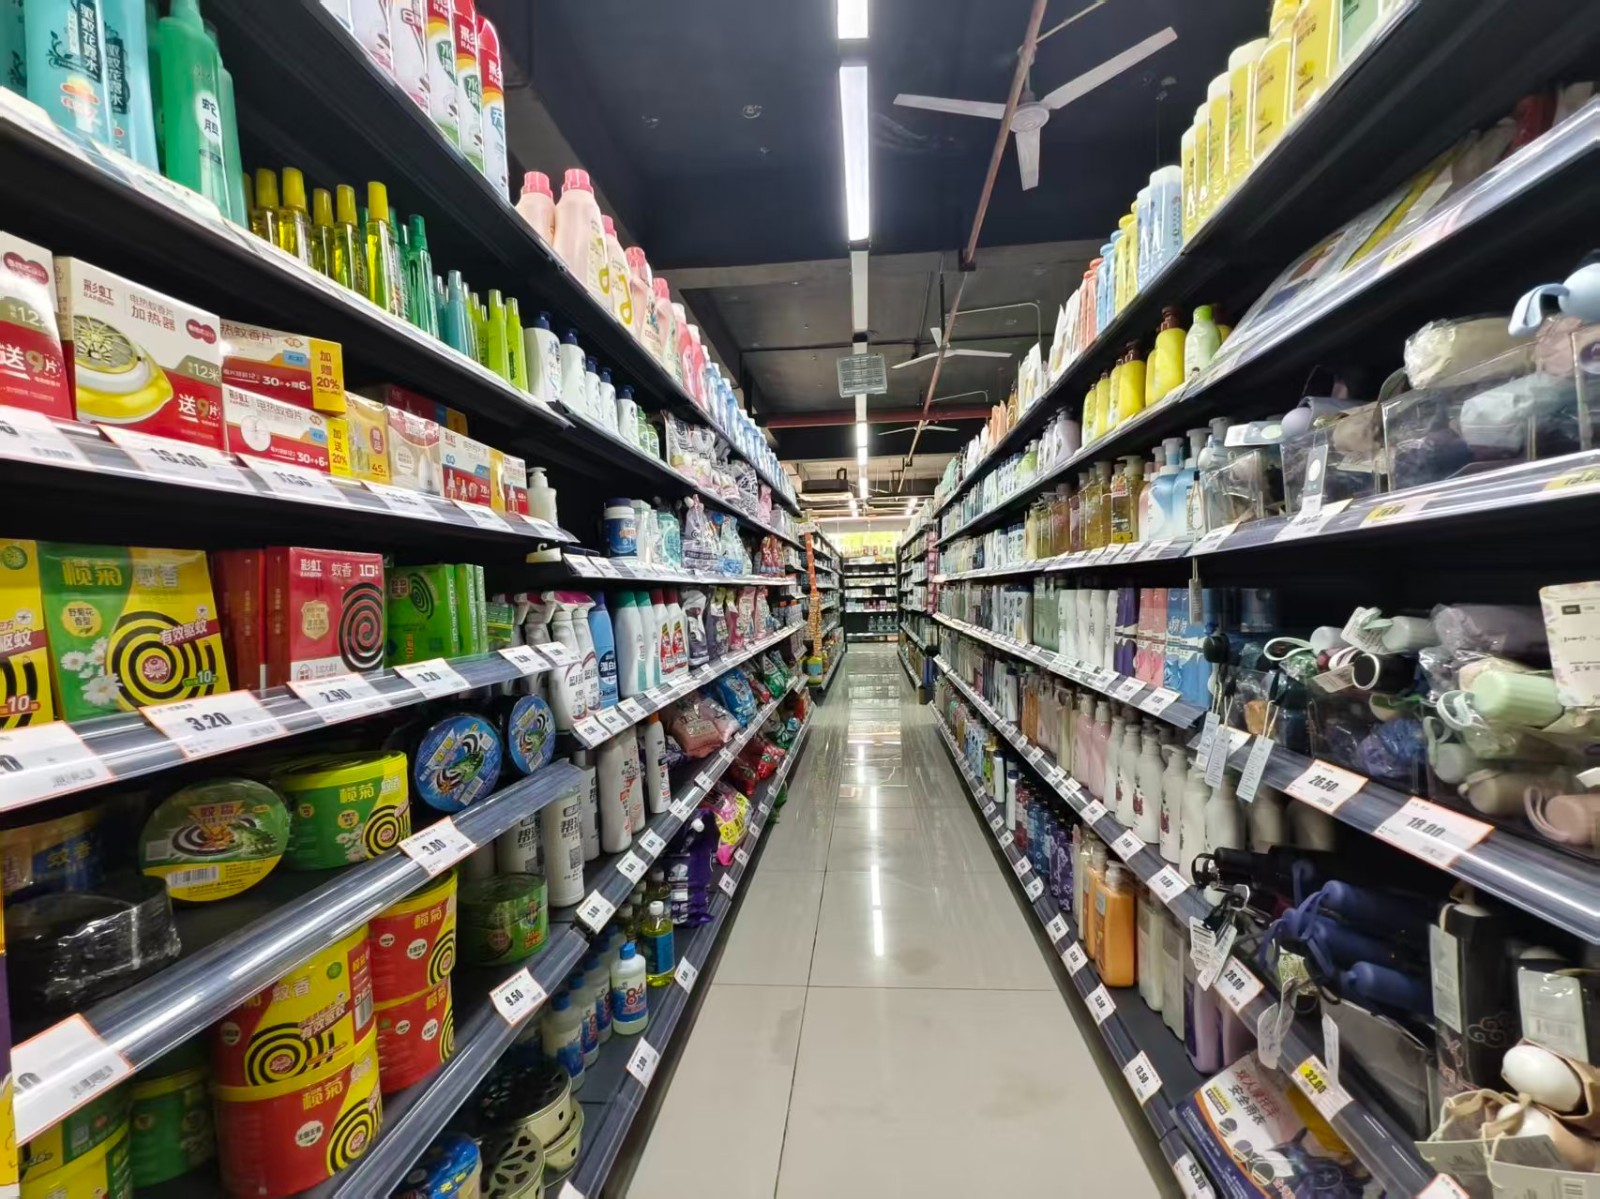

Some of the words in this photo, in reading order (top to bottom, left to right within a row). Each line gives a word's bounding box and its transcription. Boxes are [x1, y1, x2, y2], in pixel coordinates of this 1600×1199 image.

[201, 97, 219, 136] 蛇胆
[83, 278, 113, 300] 彩虹
[129, 294, 174, 318] 电热蚊香片
[130, 305, 175, 332] 加热器
[316, 376, 341, 391] 20%
[332, 453, 348, 466] 20%
[135, 564, 179, 588] 蚊香
[300, 559, 322, 572] 彩虹
[330, 563, 353, 579] 蚊香
[68, 607, 94, 618] 野菊花
[74, 616, 91, 626] 香型
[160, 620, 208, 646] 有效驱蚊
[319, 688, 352, 703] 2.90
[185, 712, 232, 732] 3.20
[1308, 774, 1339, 792] 26.50
[1407, 816, 1446, 838] 18.00
[1224, 969, 1245, 991] 26.00
[504, 989, 524, 1006] 9.50
[626, 982, 644, 1005] 84
[1304, 1069, 1327, 1094] 32.00
[1228, 1084, 1267, 1126] 安全雨衣
